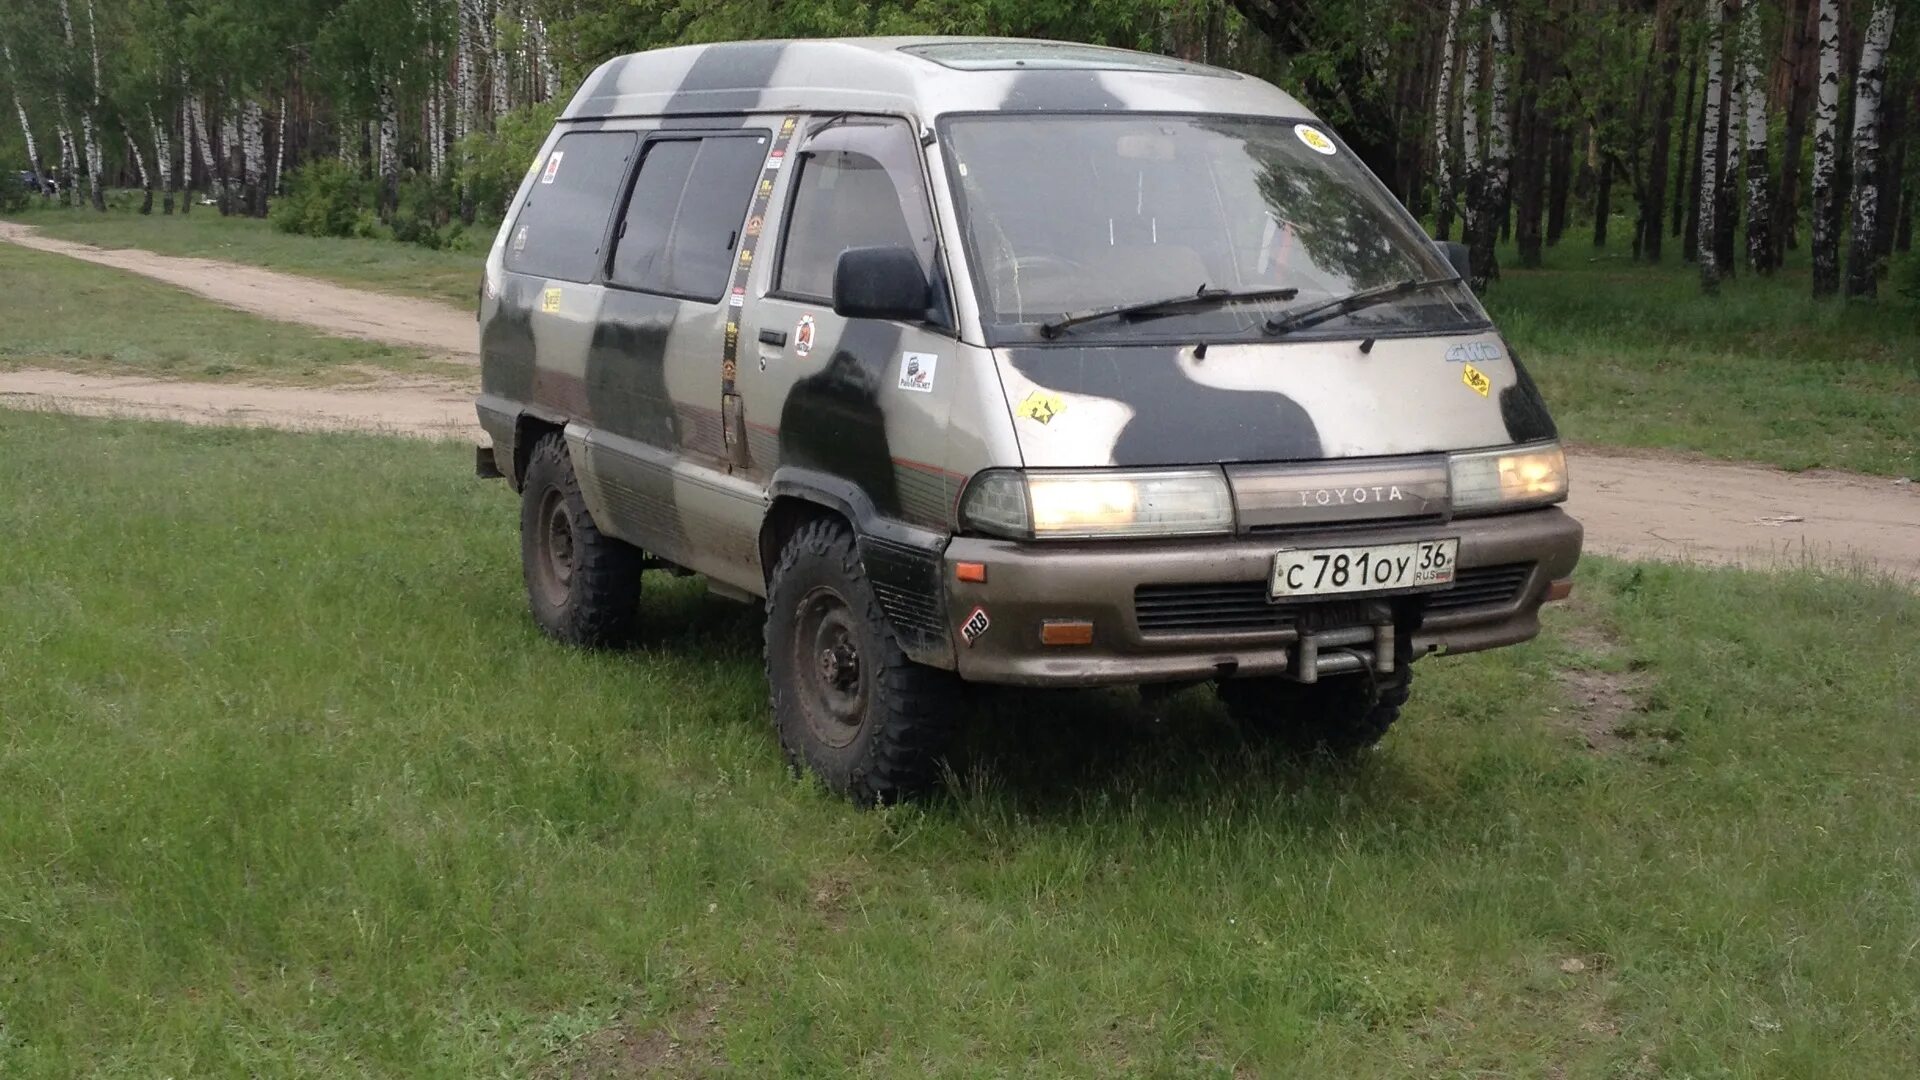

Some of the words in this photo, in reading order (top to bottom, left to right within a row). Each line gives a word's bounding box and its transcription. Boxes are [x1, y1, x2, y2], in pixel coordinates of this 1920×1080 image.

[1445, 342, 1502, 362] 4WD
[1299, 486, 1402, 506] TOYOTA
[1420, 543, 1447, 570] 36
[1415, 570, 1436, 582] RUS
[963, 611, 988, 647] ARB
